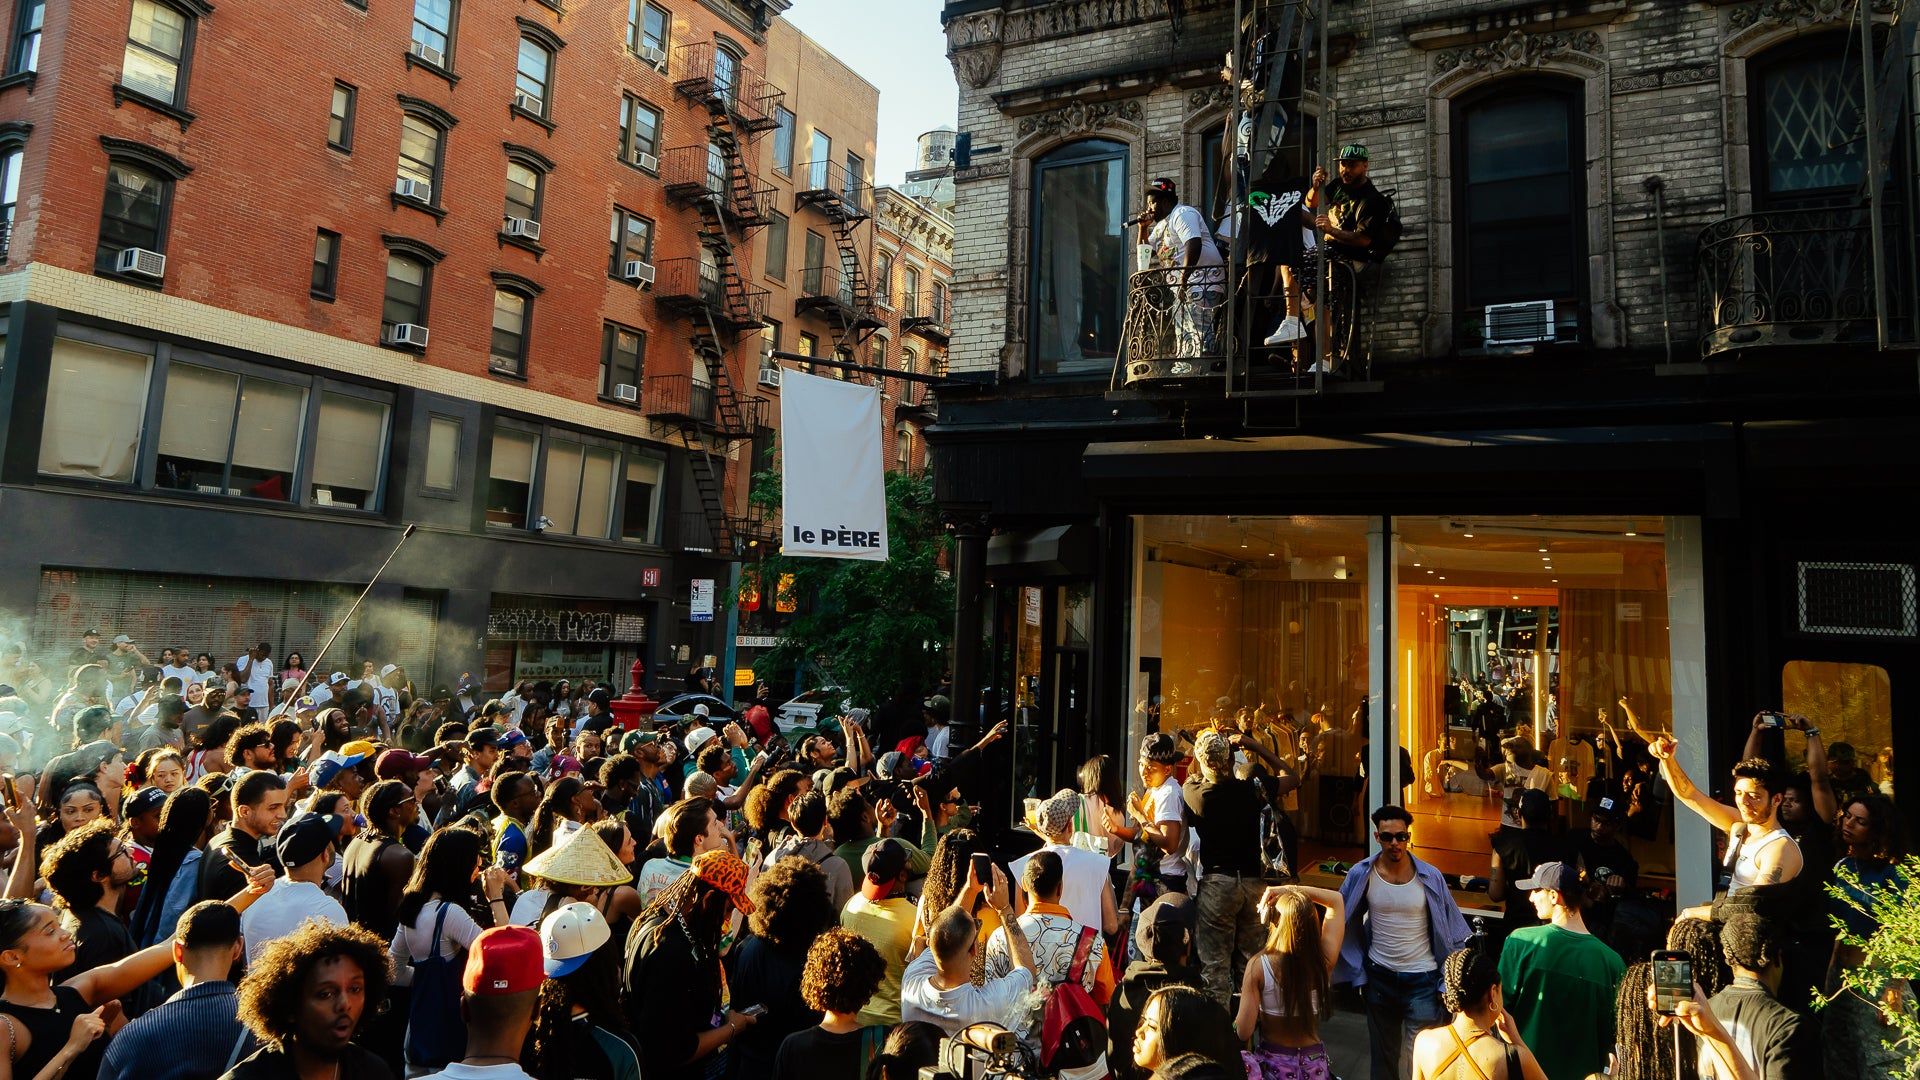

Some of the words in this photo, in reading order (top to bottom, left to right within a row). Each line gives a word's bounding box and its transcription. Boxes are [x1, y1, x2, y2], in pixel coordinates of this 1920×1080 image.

[793, 525, 816, 544] le
[821, 524, 880, 548] PÈRE
[745, 636, 758, 646] BIG
